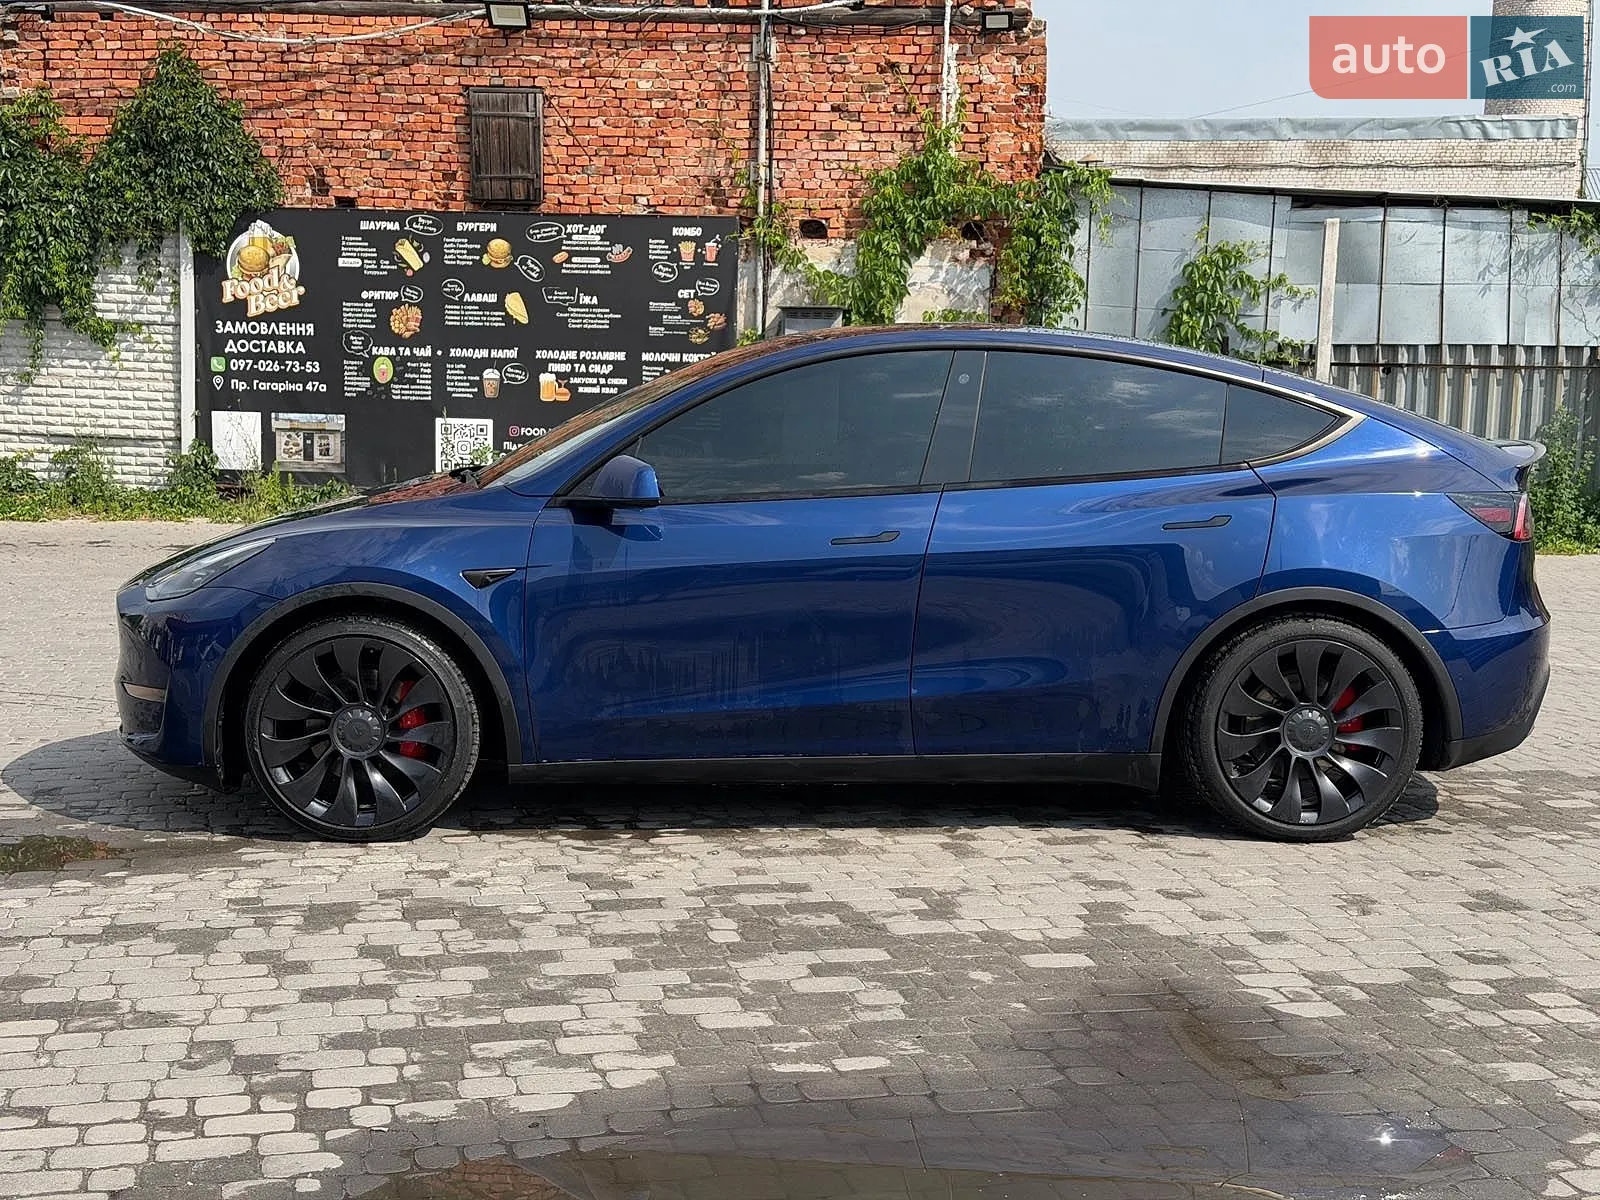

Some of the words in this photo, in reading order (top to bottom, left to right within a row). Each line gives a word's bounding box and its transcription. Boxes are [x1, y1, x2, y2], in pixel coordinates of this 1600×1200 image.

[359, 220, 400, 231] ШАУРМА
[456, 222, 497, 232] БУРГЕРИ
[566, 224, 607, 234] ХОТ-ДОГ
[672, 226, 702, 237] КОМБО
[361, 290, 399, 300] ФРИТЮР
[463, 292, 498, 303] ЛАВАШ
[579, 293, 598, 305] ЇЖА
[677, 289, 696, 299] СЕТ
[247, 285, 306, 317] Beer
[215, 320, 314, 336] ЗАМОВЛЕННЯ
[224, 339, 306, 354] ДОСТАВКА
[371, 346, 396, 356] КАВА
[398, 347, 411, 356] ТА
[413, 345, 432, 357] ЧАЙ
[449, 348, 488, 359] ХОЛОДНІ
[490, 347, 519, 359] НАПОЇ
[535, 349, 578, 361] ХОЛОДНЕ
[579, 350, 626, 361] РОЗЛИВНЕ
[641, 351, 680, 362] МОЛОЧНІ
[230, 359, 320, 373] 097-026-73-53
[548, 362, 572, 372] ПИВО
[573, 363, 586, 373] ТА
[588, 364, 613, 375] СИДР
[230, 378, 250, 392] Пр.
[253, 380, 303, 393] Гагаріна
[305, 381, 327, 392] 47а
[601, 386, 618, 394] КВАС
